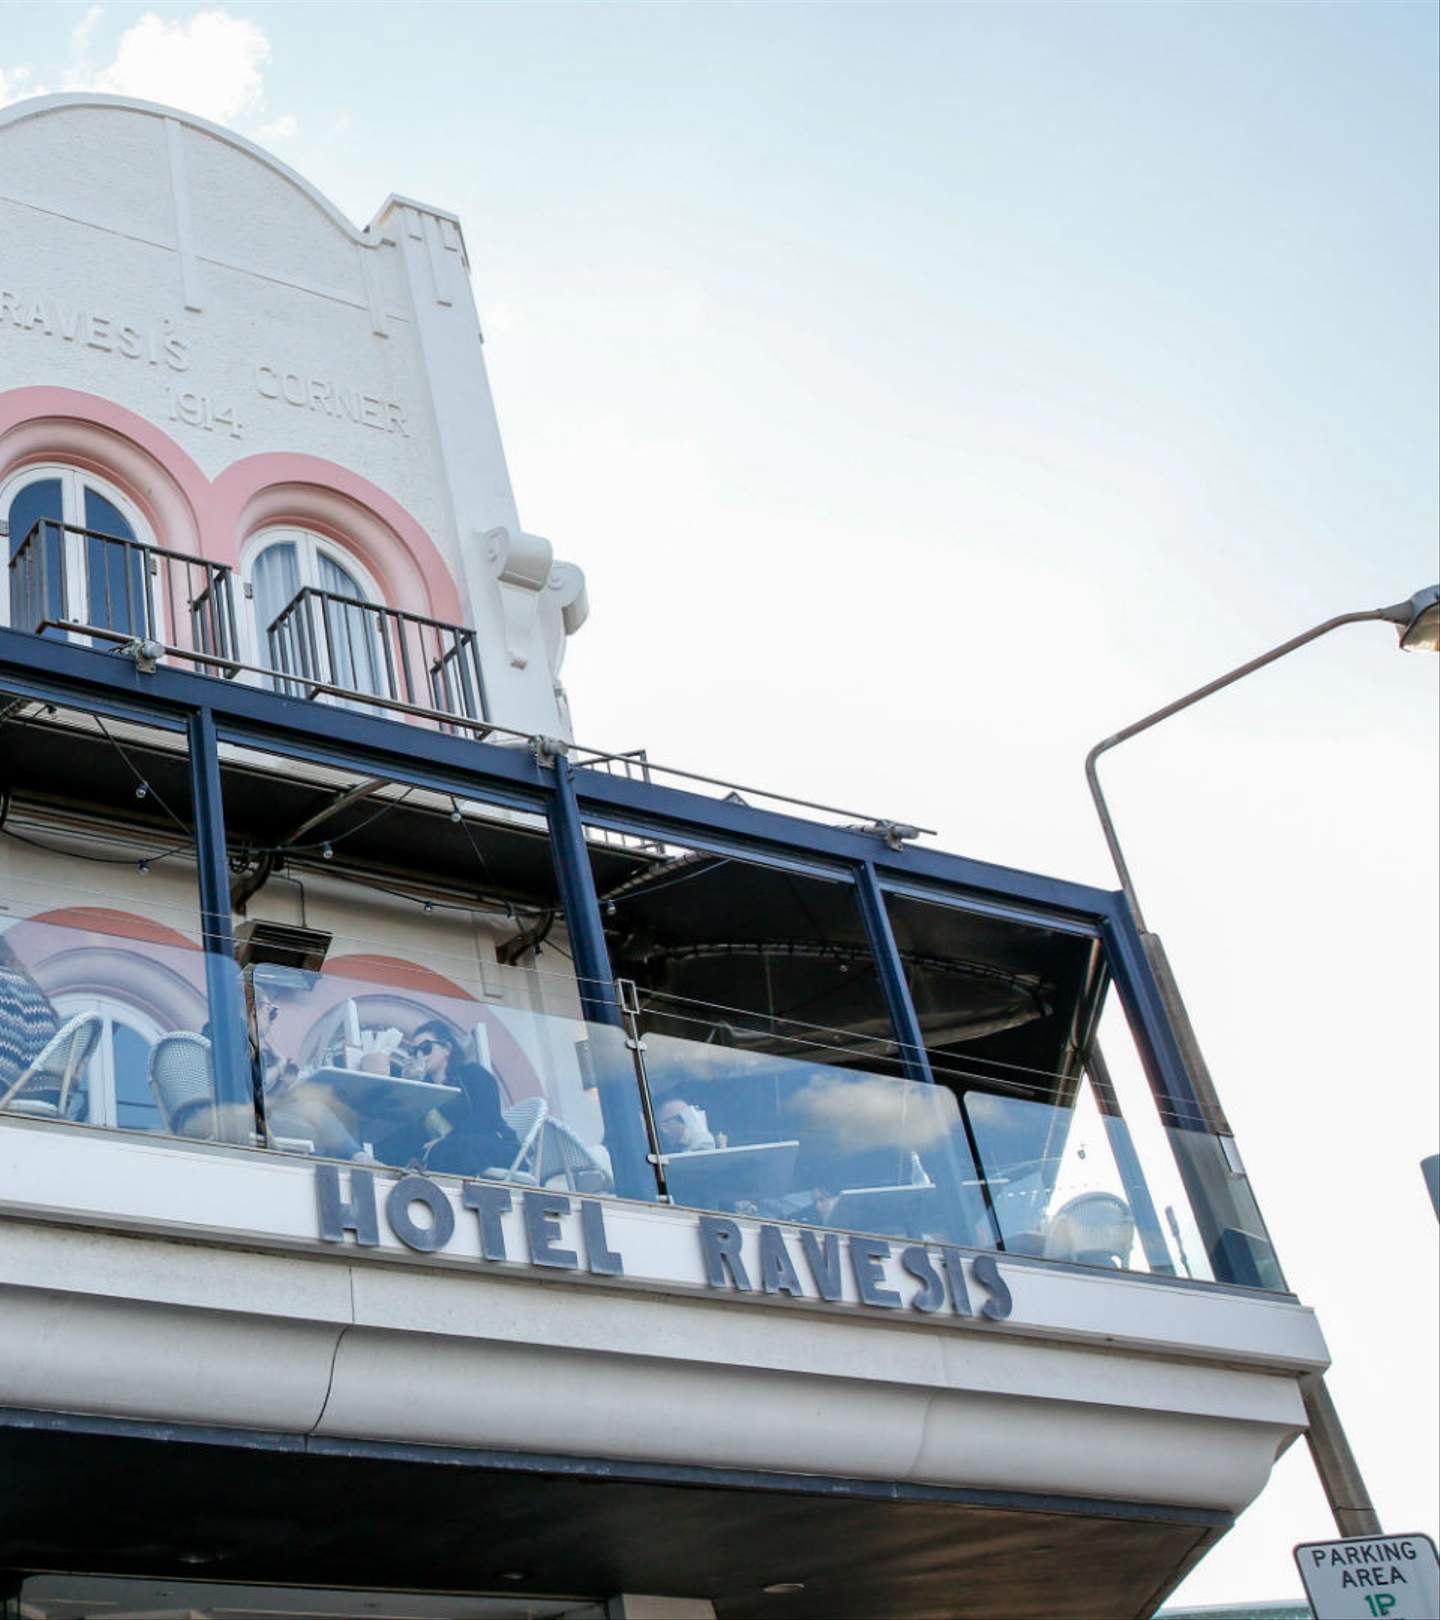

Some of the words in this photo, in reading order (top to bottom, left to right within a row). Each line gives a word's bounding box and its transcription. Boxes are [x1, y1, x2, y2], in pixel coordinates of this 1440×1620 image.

[163, 383, 244, 441] 1914
[256, 364, 411, 439] CORNER
[313, 1162, 624, 1277] HOTEL
[698, 1214, 1015, 1322] RAVESIS
[1311, 1541, 1417, 1568] PARKING
[1341, 1566, 1407, 1589] AREA
[1363, 1593, 1397, 1618] 1P
